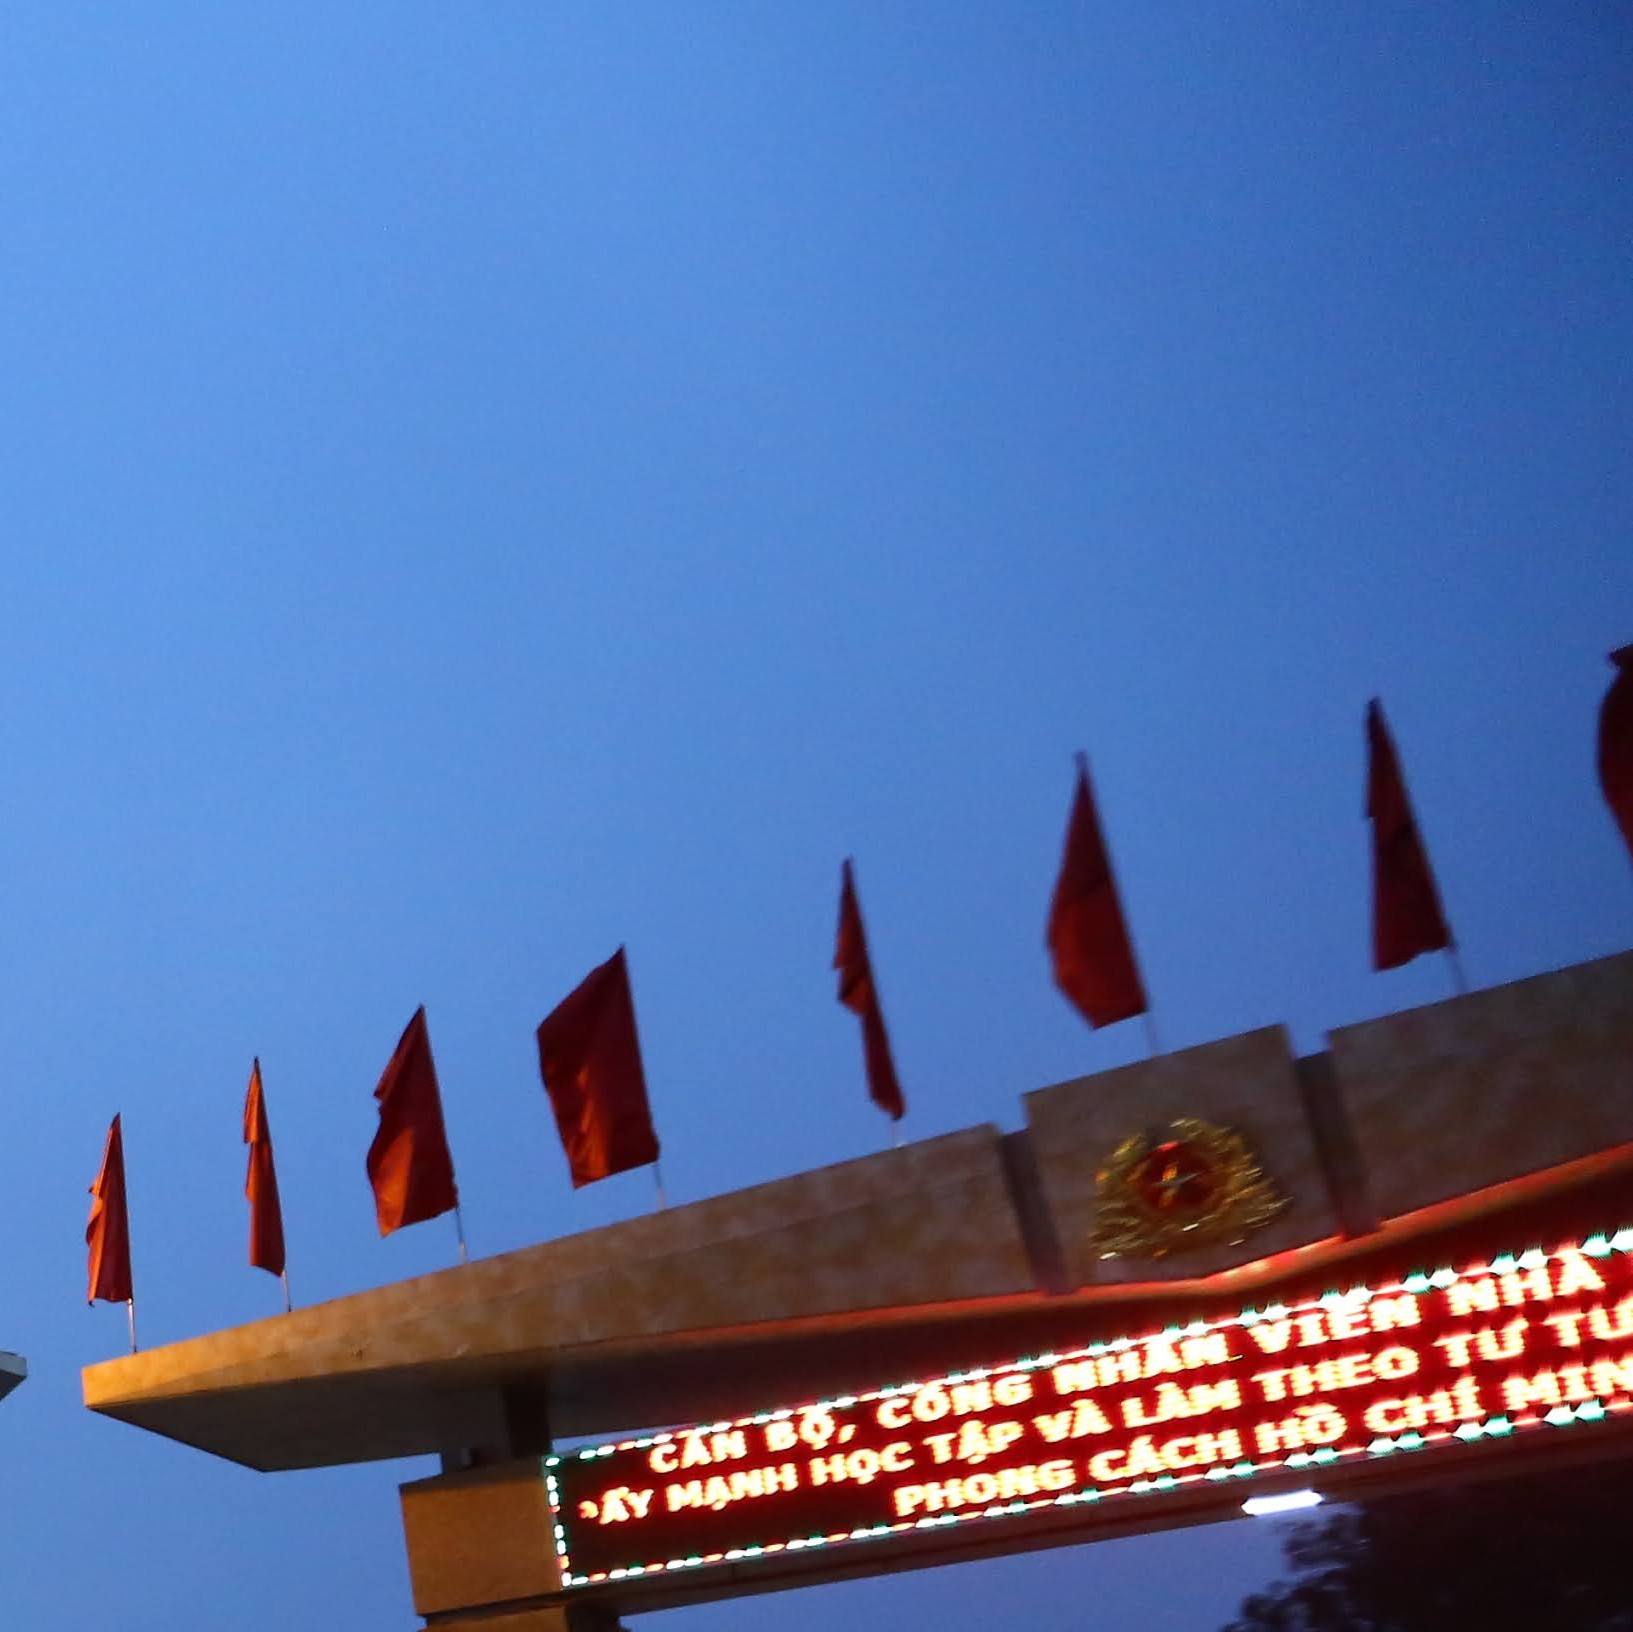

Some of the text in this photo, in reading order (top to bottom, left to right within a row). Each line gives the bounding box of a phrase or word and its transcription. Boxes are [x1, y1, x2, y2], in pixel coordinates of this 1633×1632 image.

[810, 1442, 915, 1485] HỌC
[1251, 1345, 1421, 1402] THEO
[893, 1458, 1076, 1518] PHONG
